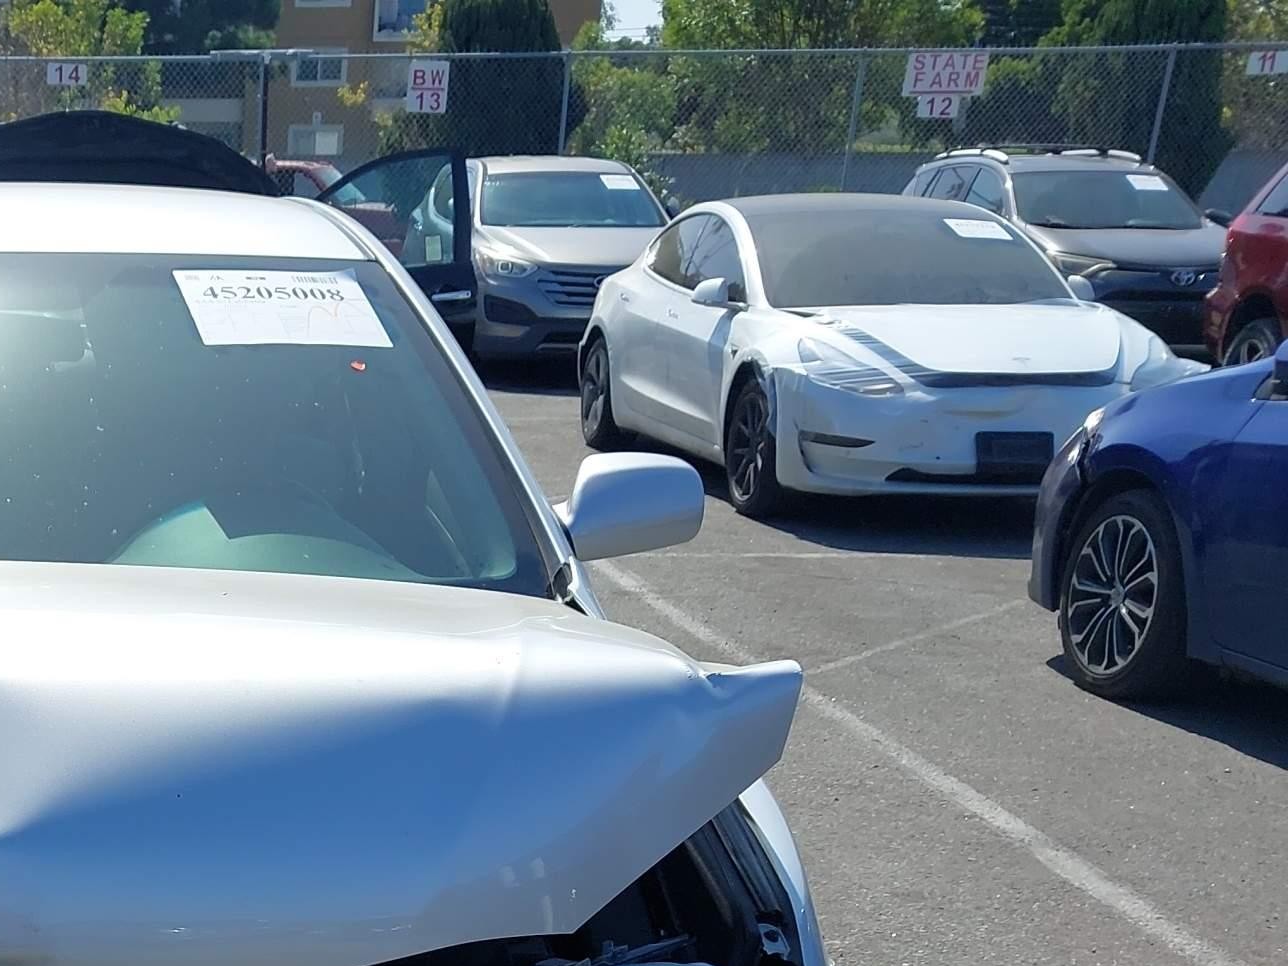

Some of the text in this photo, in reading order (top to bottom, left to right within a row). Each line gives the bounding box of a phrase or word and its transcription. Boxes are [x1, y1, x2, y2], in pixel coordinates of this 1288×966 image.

[913, 53, 985, 71] STATE
[1258, 51, 1277, 73] 11
[55, 64, 81, 83] 14
[913, 71, 980, 89] FARM
[415, 92, 441, 111] 13
[926, 97, 953, 116] 12
[202, 285, 345, 302] 45205008
